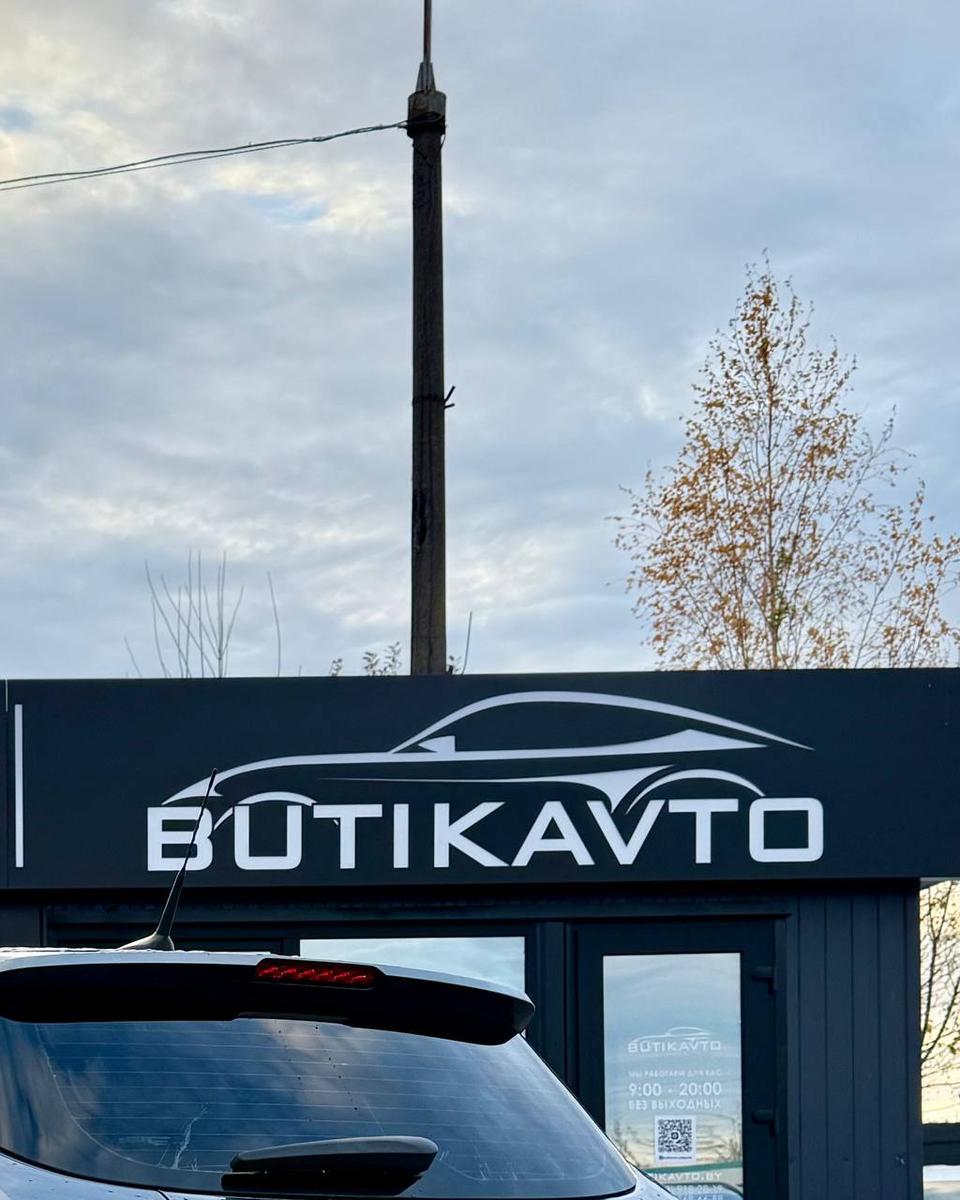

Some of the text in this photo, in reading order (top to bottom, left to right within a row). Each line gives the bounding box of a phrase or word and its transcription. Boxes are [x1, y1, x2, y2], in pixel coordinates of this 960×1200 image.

[146, 796, 825, 873] BUTIKAVTO
[627, 1040, 721, 1053] BUTIKAVTO
[628, 1082, 661, 1097] 9:00
[679, 1081, 722, 1096] 20:00
[628, 1099, 721, 1111] БЕЗ ВЫХОДНЫХ
